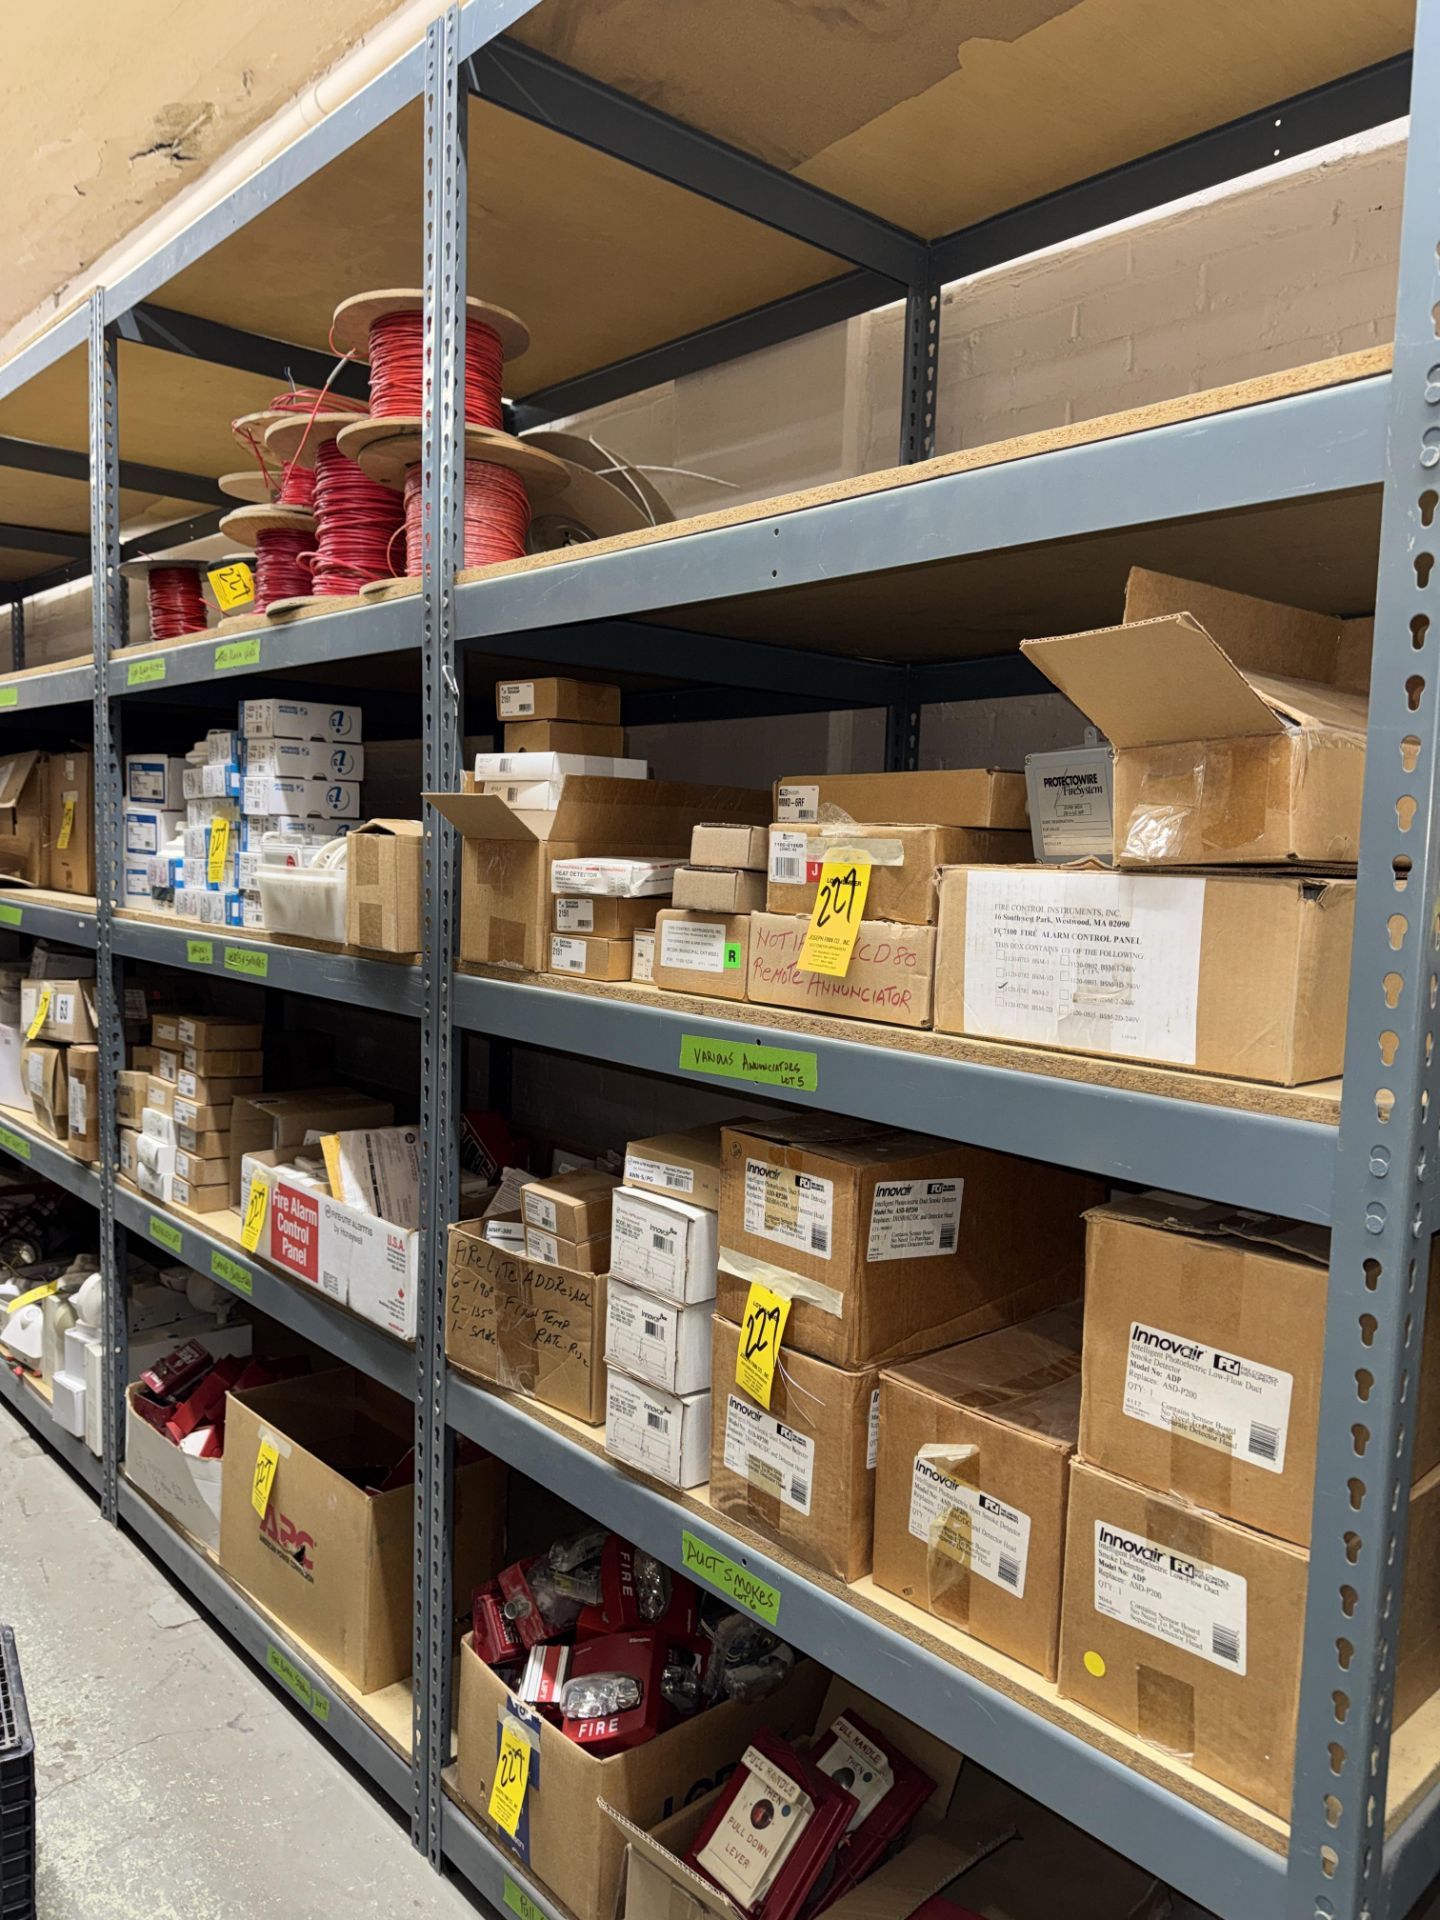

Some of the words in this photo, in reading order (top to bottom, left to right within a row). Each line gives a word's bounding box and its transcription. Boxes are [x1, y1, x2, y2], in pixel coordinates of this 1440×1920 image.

[1043, 774, 1098, 788] PROTECTOWIRE
[994, 903, 1009, 911] FIRE
[1011, 904, 1044, 913] CONTROL
[1020, 928, 1037, 936] FIRE
[1041, 931, 1069, 939] ALARM
[1071, 933, 1112, 943] CONTROL
[1113, 935, 1142, 945] PANEL
[1094, 919, 1107, 927] MA
[1108, 920, 1130, 928] 02090
[728, 950, 736, 962] R
[1084, 948, 1098, 956] THE
[876, 1184, 913, 1197] Innovair
[273, 1188, 289, 1212] Fire
[291, 1197, 317, 1226] Alarm
[278, 1213, 309, 1245] Control
[283, 1237, 306, 1266] Panel
[1131, 1351, 1152, 1364] Smoke
[1153, 1359, 1181, 1374] Detector
[1132, 1325, 1204, 1361] Innovair
[1219, 1357, 1239, 1375] FCI
[1130, 1360, 1150, 1372] Model
[1166, 1373, 1182, 1384] ADP
[1131, 1342, 1163, 1358] Intelligent
[1165, 1354, 1206, 1375] Photoelectric
[1208, 1368, 1244, 1387] Low-Flow
[1245, 1381, 1262, 1394] Duct
[1162, 1382, 1197, 1399] ASD-P200
[729, 1396, 762, 1421] Innovair
[1161, 1407, 1171, 1416] No
[1161, 1401, 1190, 1417] Contains
[1191, 1411, 1213, 1425] Sensor
[1215, 1420, 1236, 1434] Board
[1160, 1414, 1187, 1430] Separate
[1189, 1425, 1218, 1441] Detector
[1220, 1436, 1237, 1449] Head
[915, 1459, 959, 1490] Innovair
[260, 1504, 314, 1569] APC
[1100, 1527, 1163, 1562] Innovair
[687, 1541, 724, 1573] DUCT
[1099, 1550, 1117, 1563] Smoke
[1120, 1558, 1144, 1573] Detector
[1099, 1541, 1127, 1558] Intelligent
[1129, 1554, 1168, 1574] Photoelectric
[1204, 1584, 1219, 1596] Duct
[1099, 1559, 1116, 1571] Model
[1132, 1573, 1146, 1582] ADP
[620, 1551, 633, 1597] FIRE
[1130, 1581, 1161, 1599] ASD-P200
[1130, 1600, 1157, 1616] Contains
[1159, 1612, 1179, 1625] Sensor
[1181, 1622, 1200, 1635] Board
[1130, 1614, 1156, 1630] Separate
[1158, 1625, 1183, 1641] Detector
[1185, 1637, 1202, 1650] Head
[578, 1718, 619, 1738] FIRE
[835, 1721, 852, 1739] PULL
[853, 1736, 881, 1764] HANDLE
[846, 1756, 864, 1775] THEN
[766, 1766, 796, 1797] HANDLE
[763, 1785, 783, 1806] THEN
[727, 1816, 746, 1838] PULL
[746, 1832, 771, 1858] DOWN
[724, 1842, 751, 1869] LEVER
